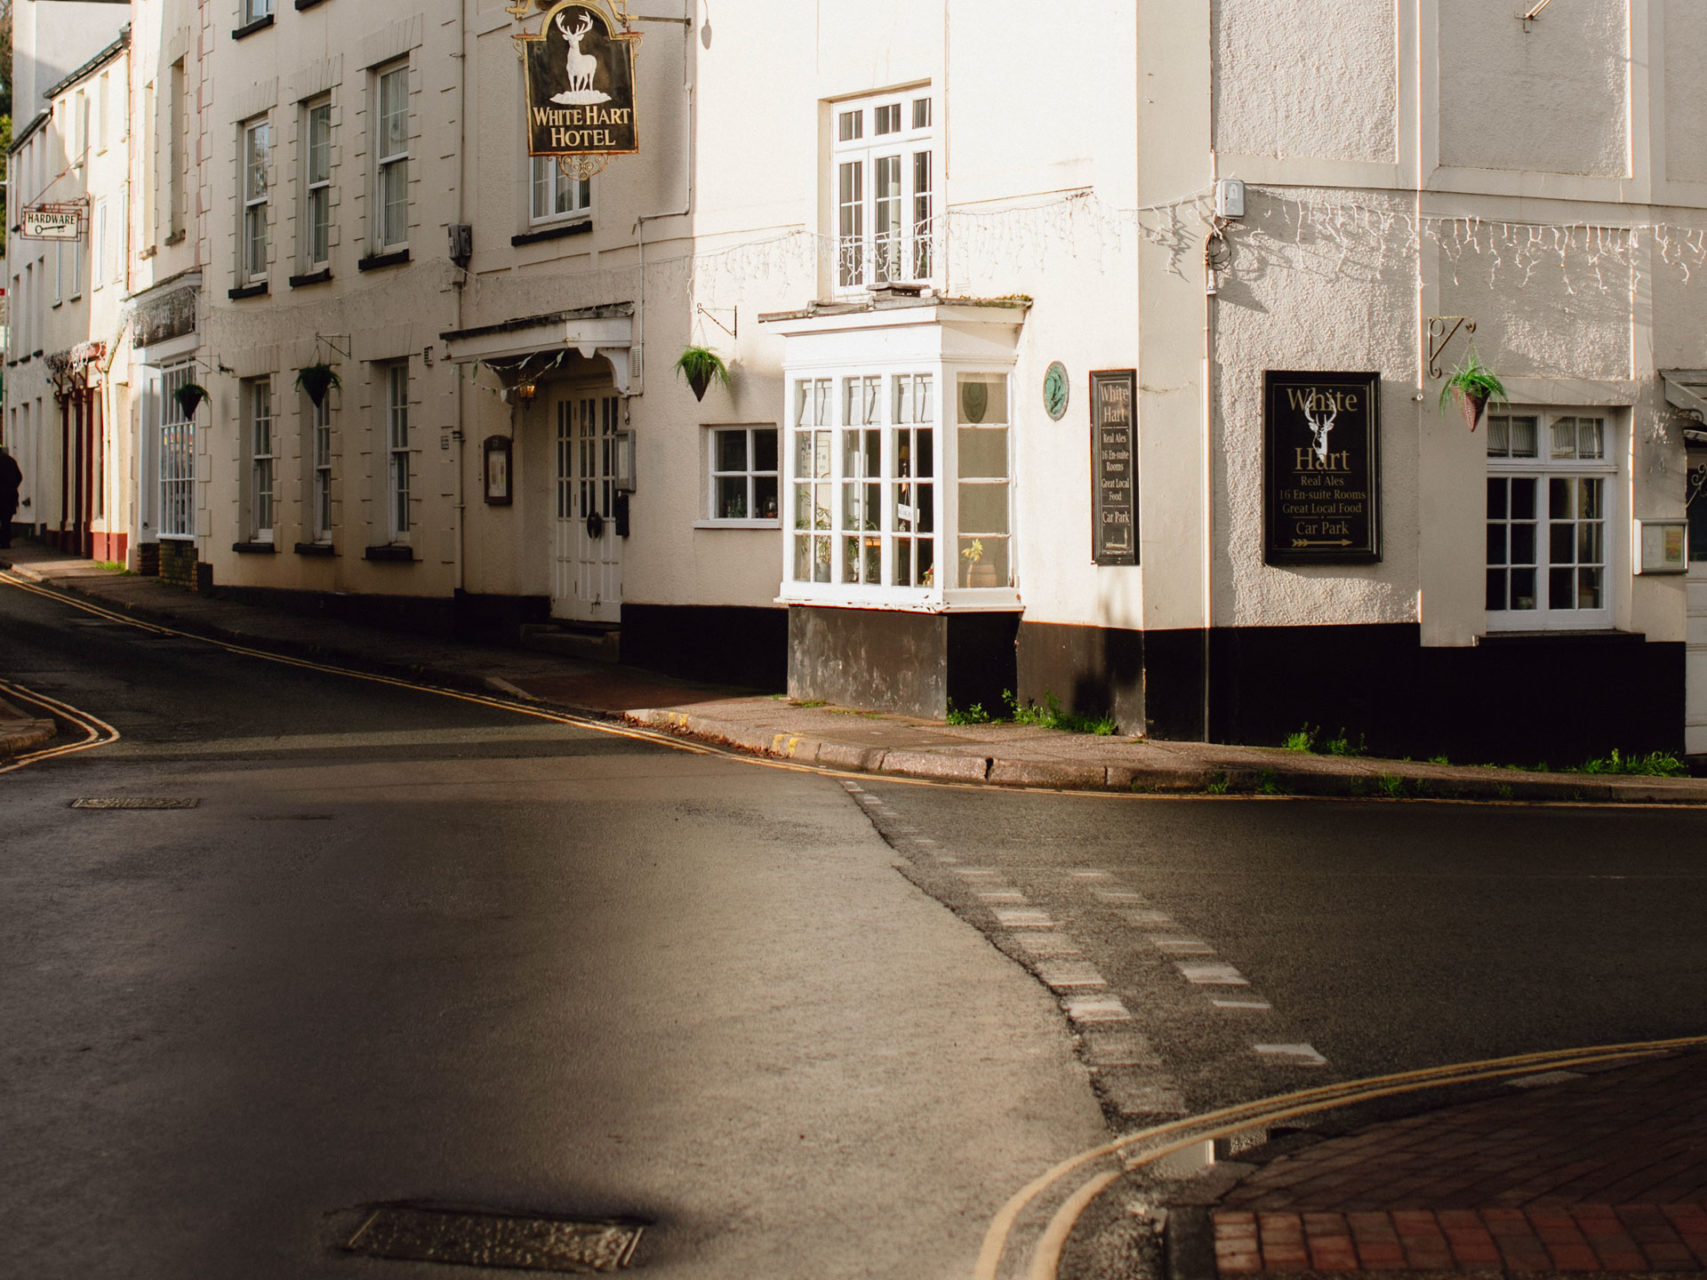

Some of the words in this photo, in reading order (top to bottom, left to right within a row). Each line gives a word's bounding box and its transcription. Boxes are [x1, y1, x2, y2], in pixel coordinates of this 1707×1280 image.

[533, 106, 583, 126] WHITE
[586, 105, 631, 125] HART
[551, 127, 616, 147] HOTEL
[27, 213, 75, 224] HARDWARE
[1100, 384, 1129, 402] White
[1286, 387, 1359, 412] White
[1104, 406, 1128, 423] Hart
[1294, 447, 1351, 471] Hart
[1106, 461, 1124, 472] Rooms
[1115, 477, 1130, 489] Local
[1301, 475, 1321, 487] Real
[1325, 475, 1345, 487] Ales
[1108, 490, 1122, 501] Food
[1280, 489, 1291, 500] 16
[1293, 489, 1331, 500] En-suite
[1334, 489, 1367, 500] Rooms
[1282, 503, 1309, 514] Great
[1311, 503, 1337, 514] Local
[1340, 502, 1362, 513] Food
[1102, 511, 1114, 524] Car
[1114, 510, 1130, 524] Park
[1295, 521, 1318, 535] Car
[1321, 520, 1350, 535] Park
